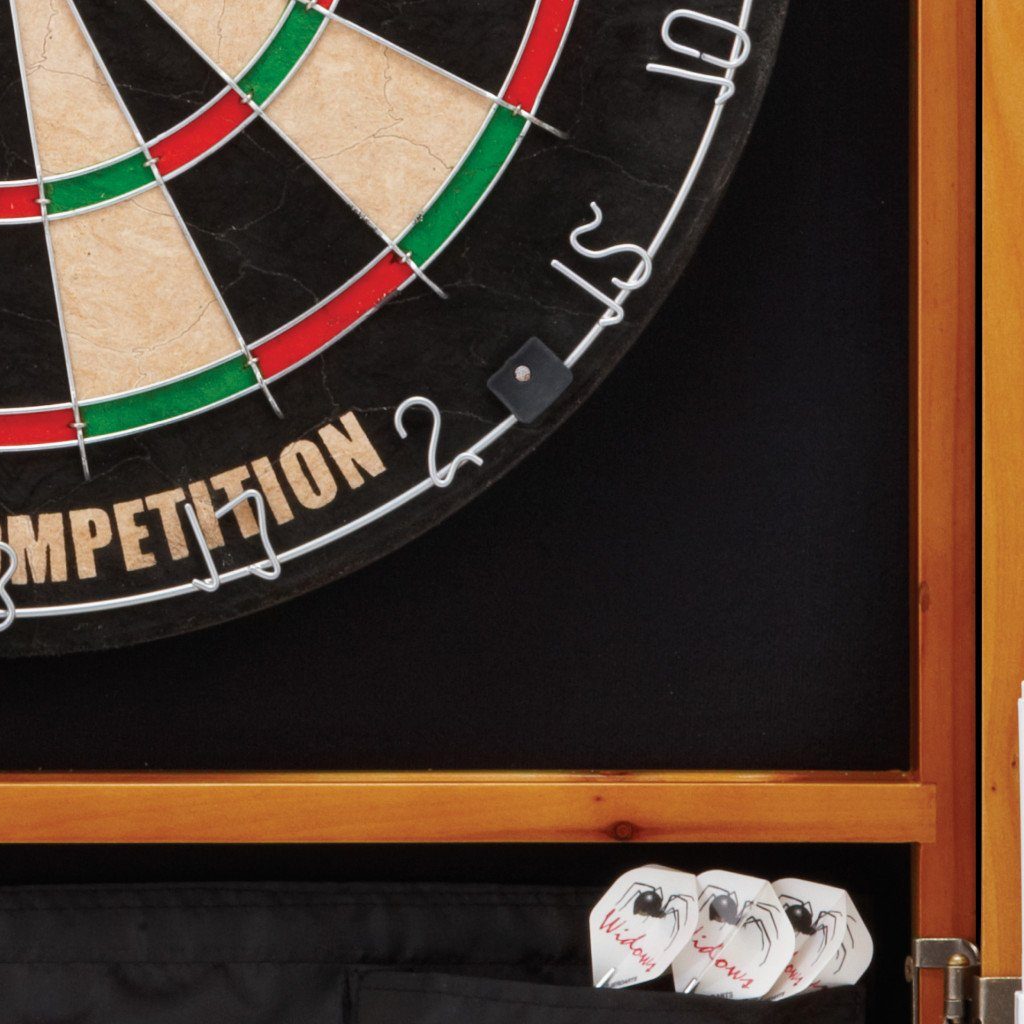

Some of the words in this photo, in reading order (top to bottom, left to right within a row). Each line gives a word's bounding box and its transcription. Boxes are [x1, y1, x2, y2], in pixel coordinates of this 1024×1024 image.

[645, 9, 751, 105] 10
[550, 201, 653, 327] 15
[395, 396, 483, 488] 2
[184, 489, 281, 592] 17
[599, 907, 656, 973] Widows
